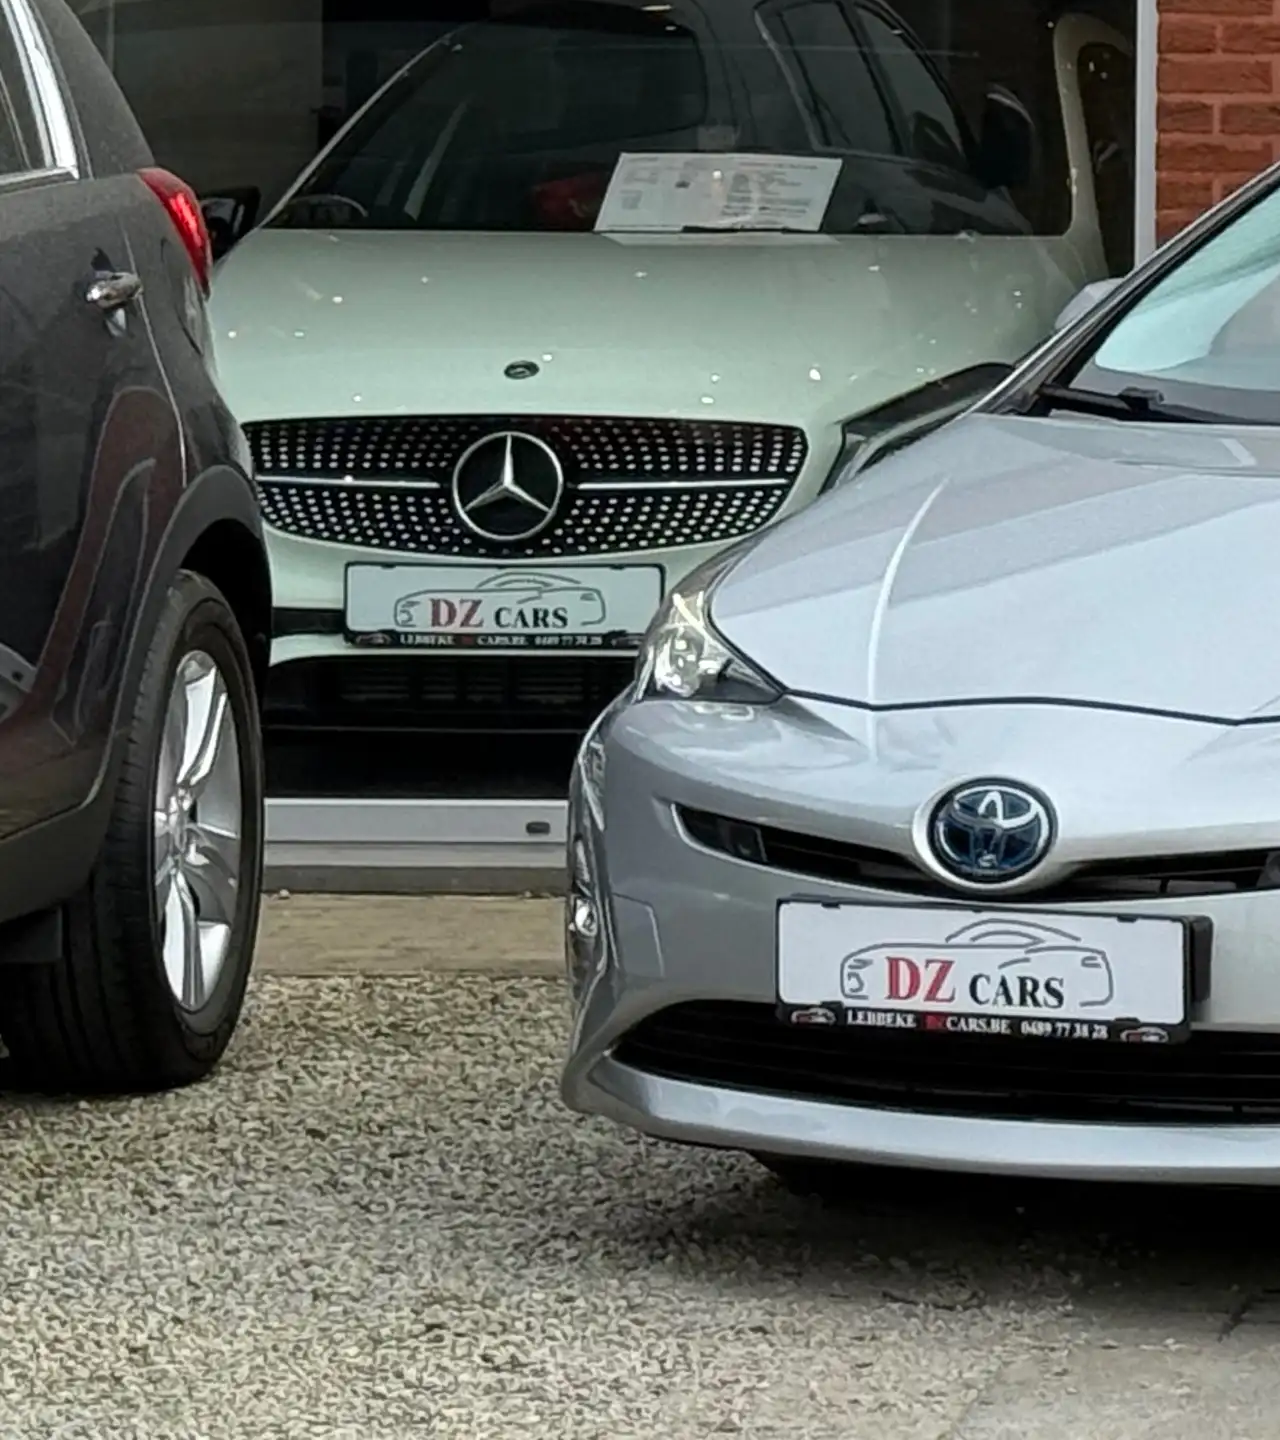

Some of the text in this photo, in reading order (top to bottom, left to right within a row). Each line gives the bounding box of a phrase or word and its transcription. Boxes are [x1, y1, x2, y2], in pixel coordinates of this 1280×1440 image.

[429, 597, 569, 629] DZ CARS
[884, 955, 1065, 1009] DZ CARS
